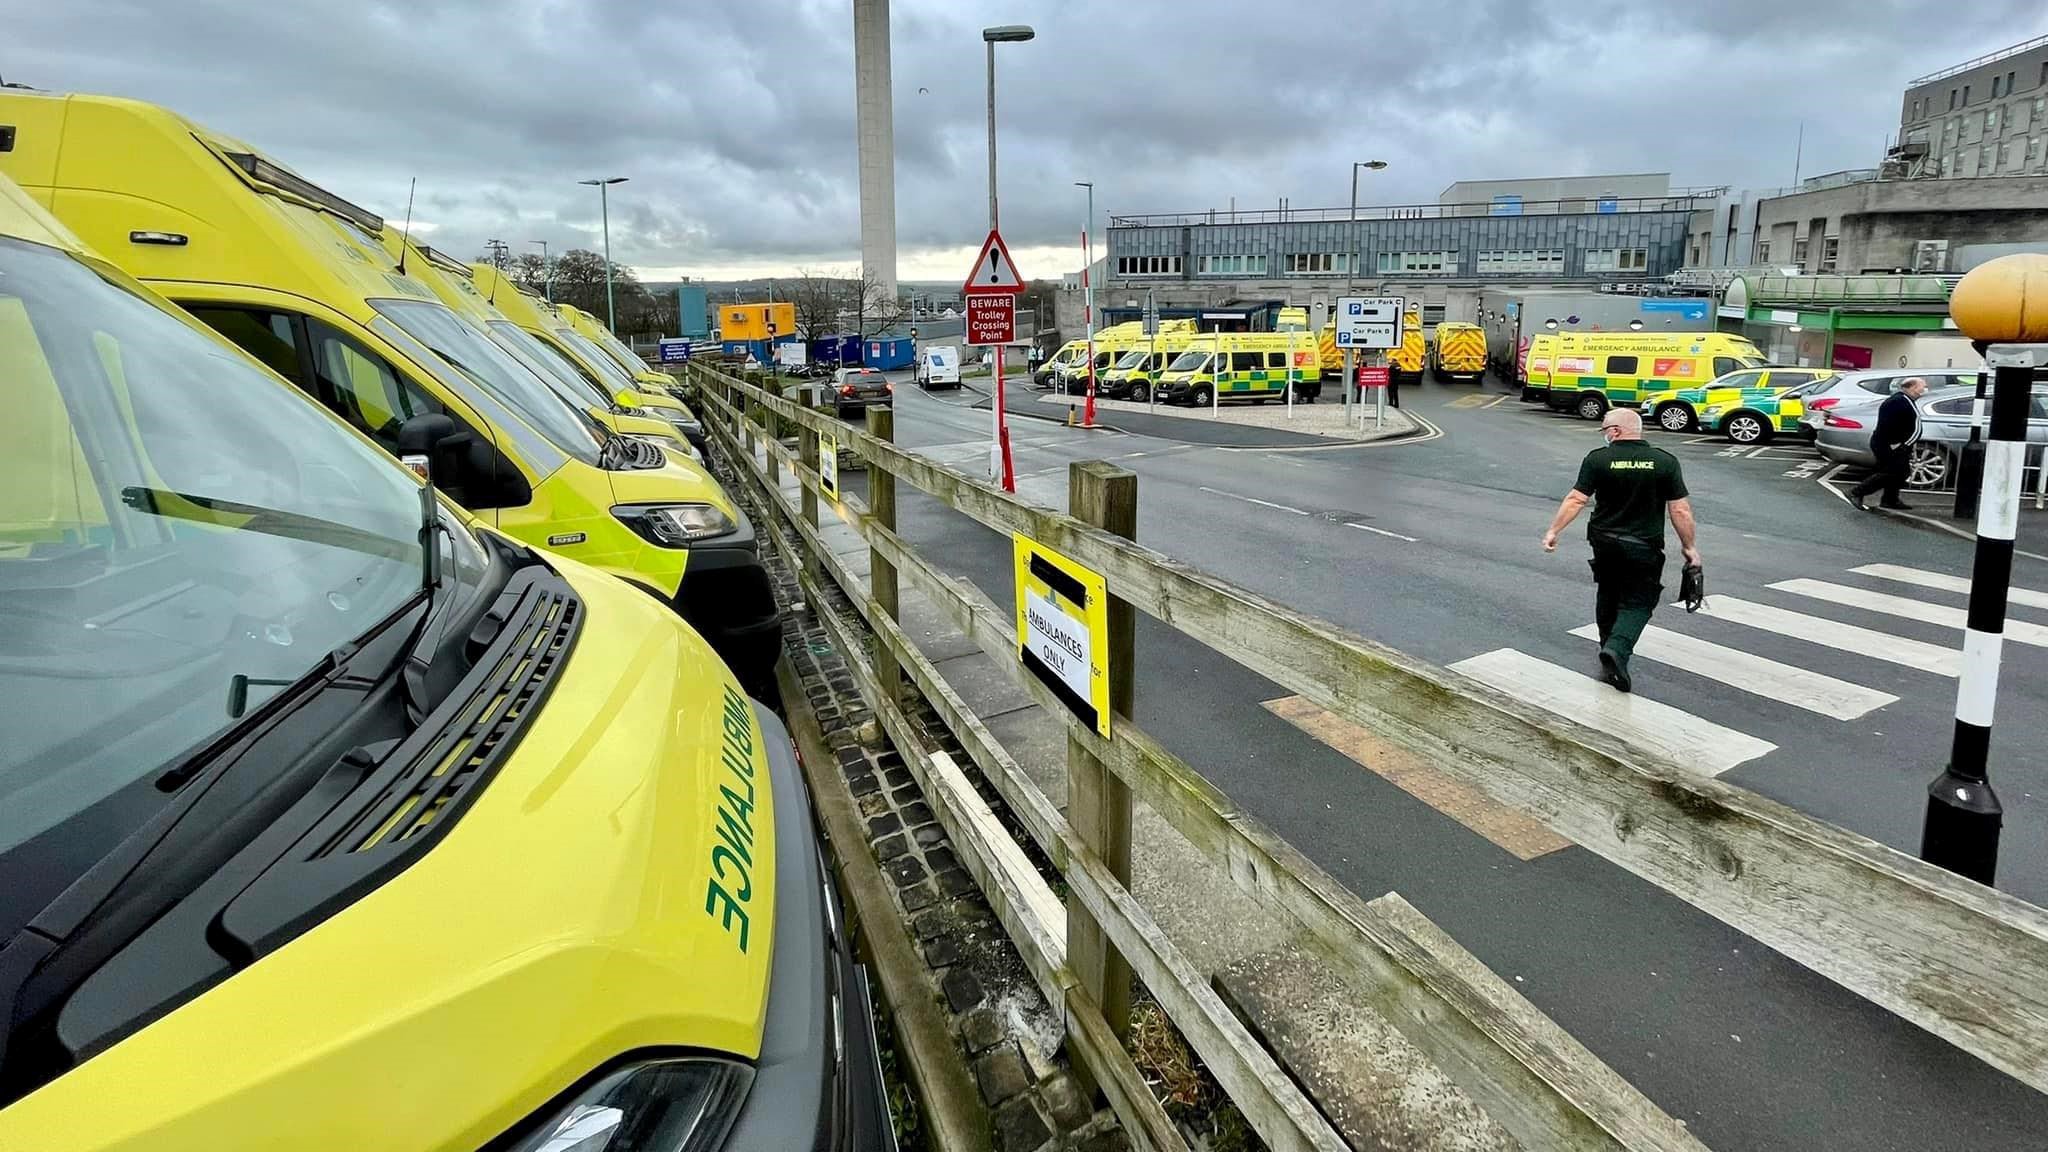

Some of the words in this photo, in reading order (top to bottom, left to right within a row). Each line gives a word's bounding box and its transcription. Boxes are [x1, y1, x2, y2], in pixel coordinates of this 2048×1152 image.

[970, 298, 1011, 308] BEWARE
[976, 310, 1006, 320] Trolley
[972, 321, 1010, 330] Crossing
[980, 331, 1003, 340] Point
[1610, 461, 1655, 470] AMBULANCE
[1028, 607, 1084, 659] AMBULANCES
[1043, 644, 1066, 672] ONLY
